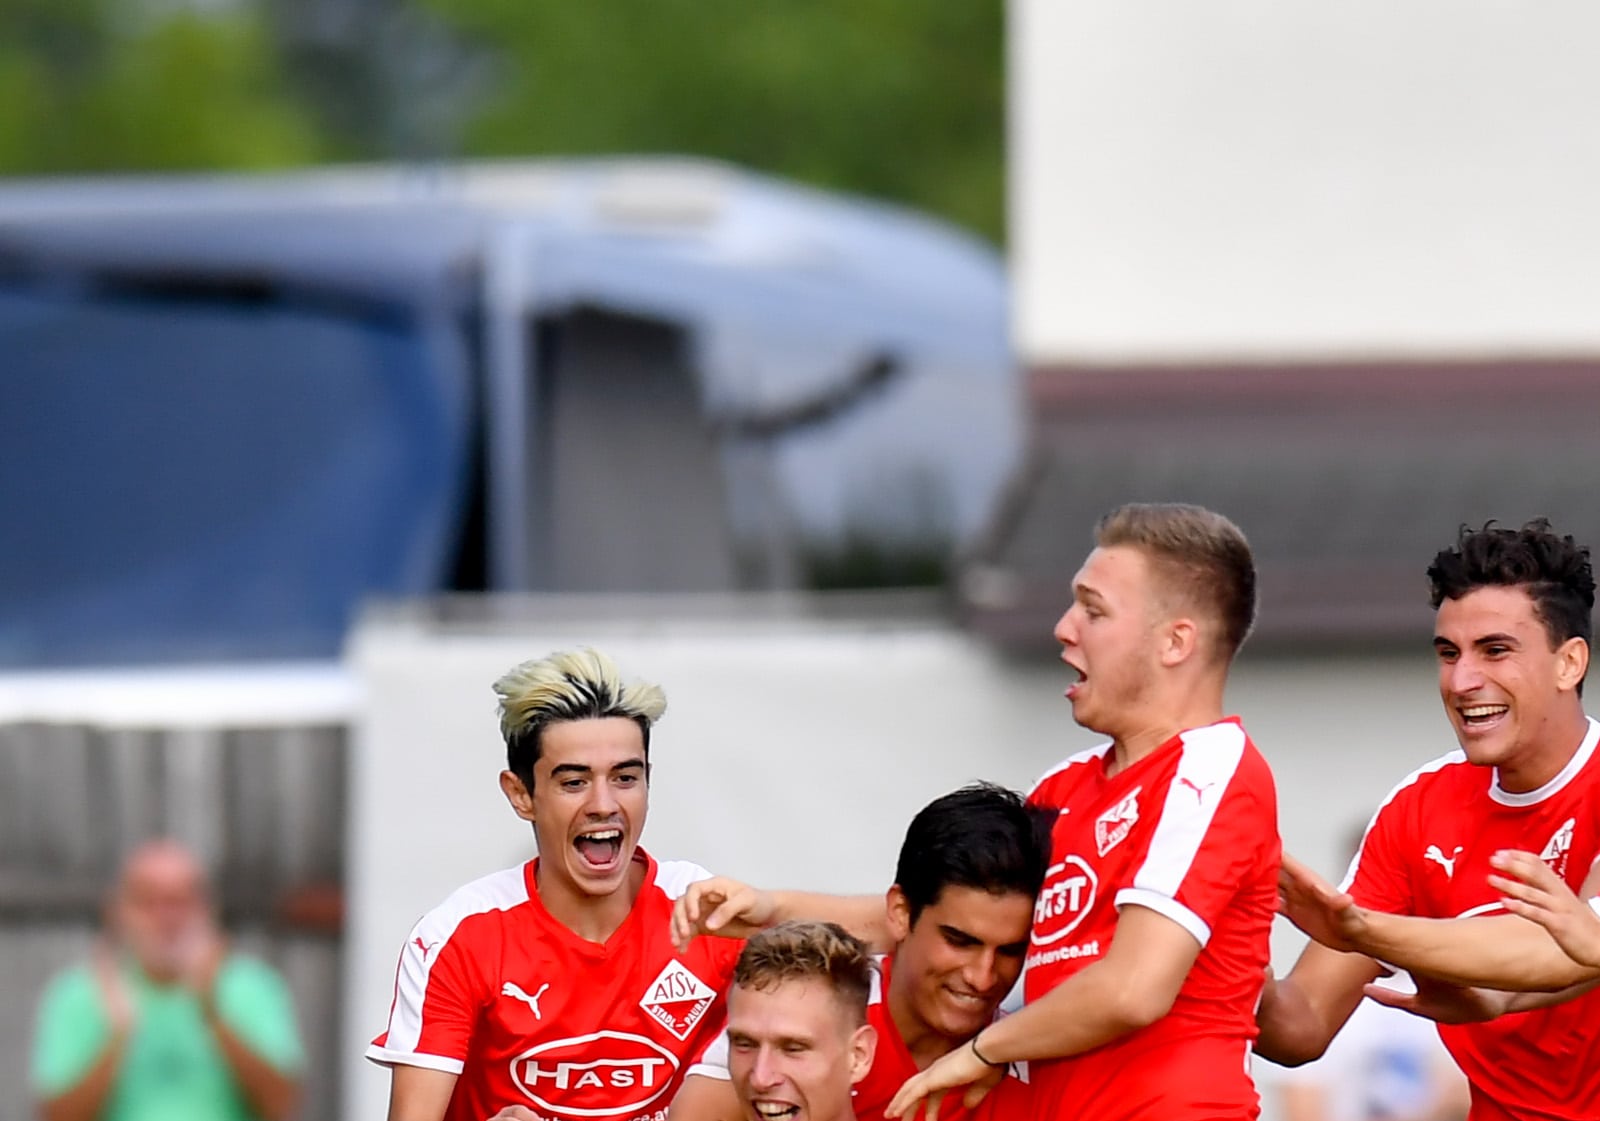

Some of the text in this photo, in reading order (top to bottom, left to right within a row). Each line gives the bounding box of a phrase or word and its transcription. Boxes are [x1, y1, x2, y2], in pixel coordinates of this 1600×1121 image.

[653, 971, 697, 1001] ATSV
[651, 1004, 676, 1028] STADL
[684, 999, 708, 1027] PAURA
[525, 1057, 666, 1089] HAST
